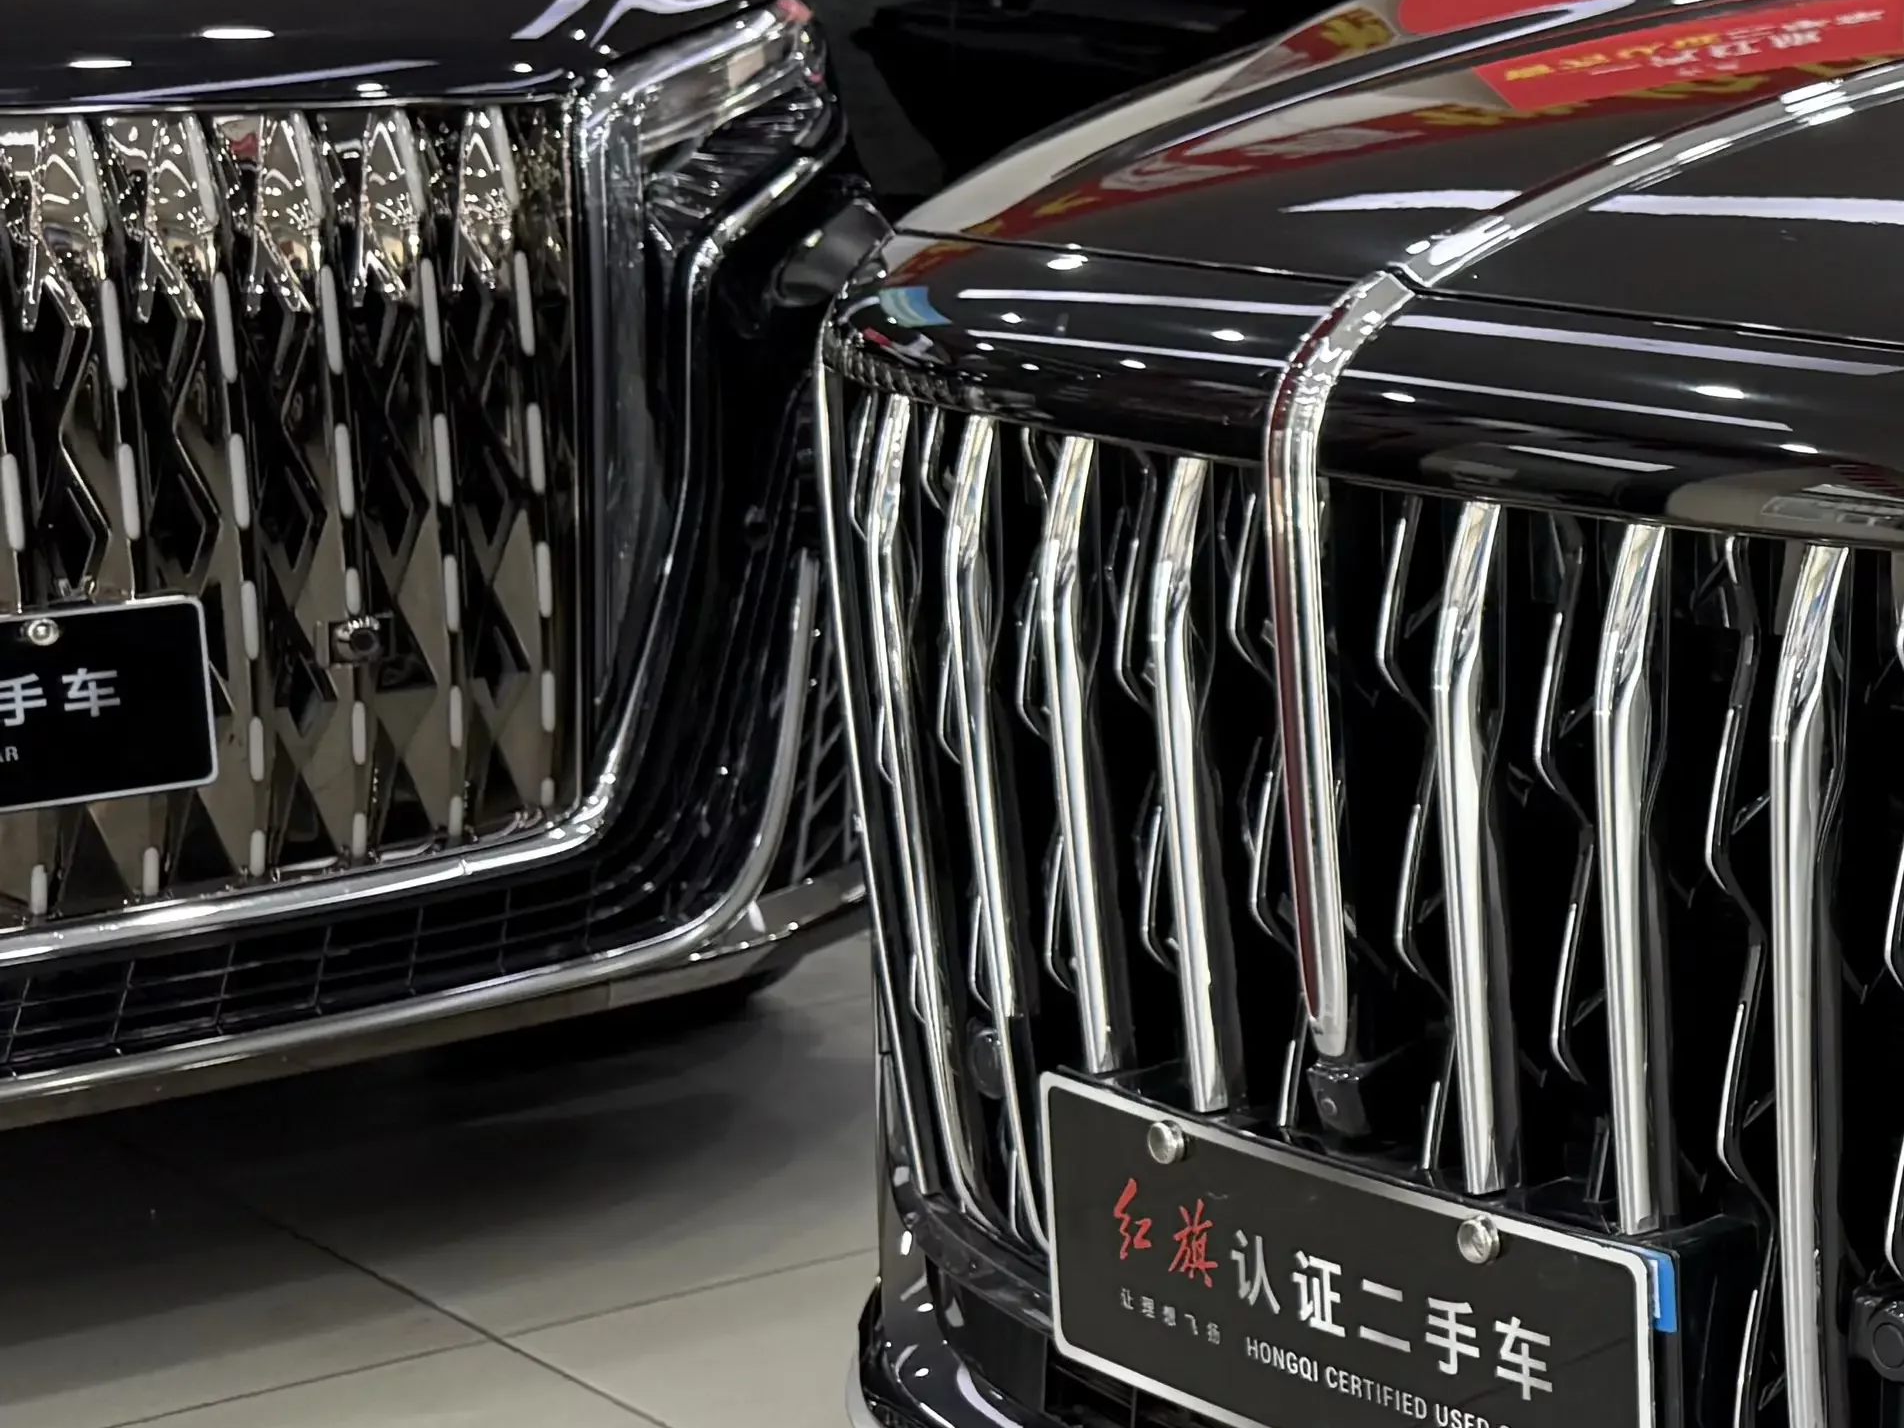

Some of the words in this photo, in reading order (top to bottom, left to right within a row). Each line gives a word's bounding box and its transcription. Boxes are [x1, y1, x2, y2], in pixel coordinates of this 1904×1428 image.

[1113, 1177, 1219, 1288] 红旗
[1230, 1229, 1553, 1401] 认证二手车
[1246, 1336, 1319, 1382] HONGQI
[1325, 1365, 1428, 1420] CERTIFIED
